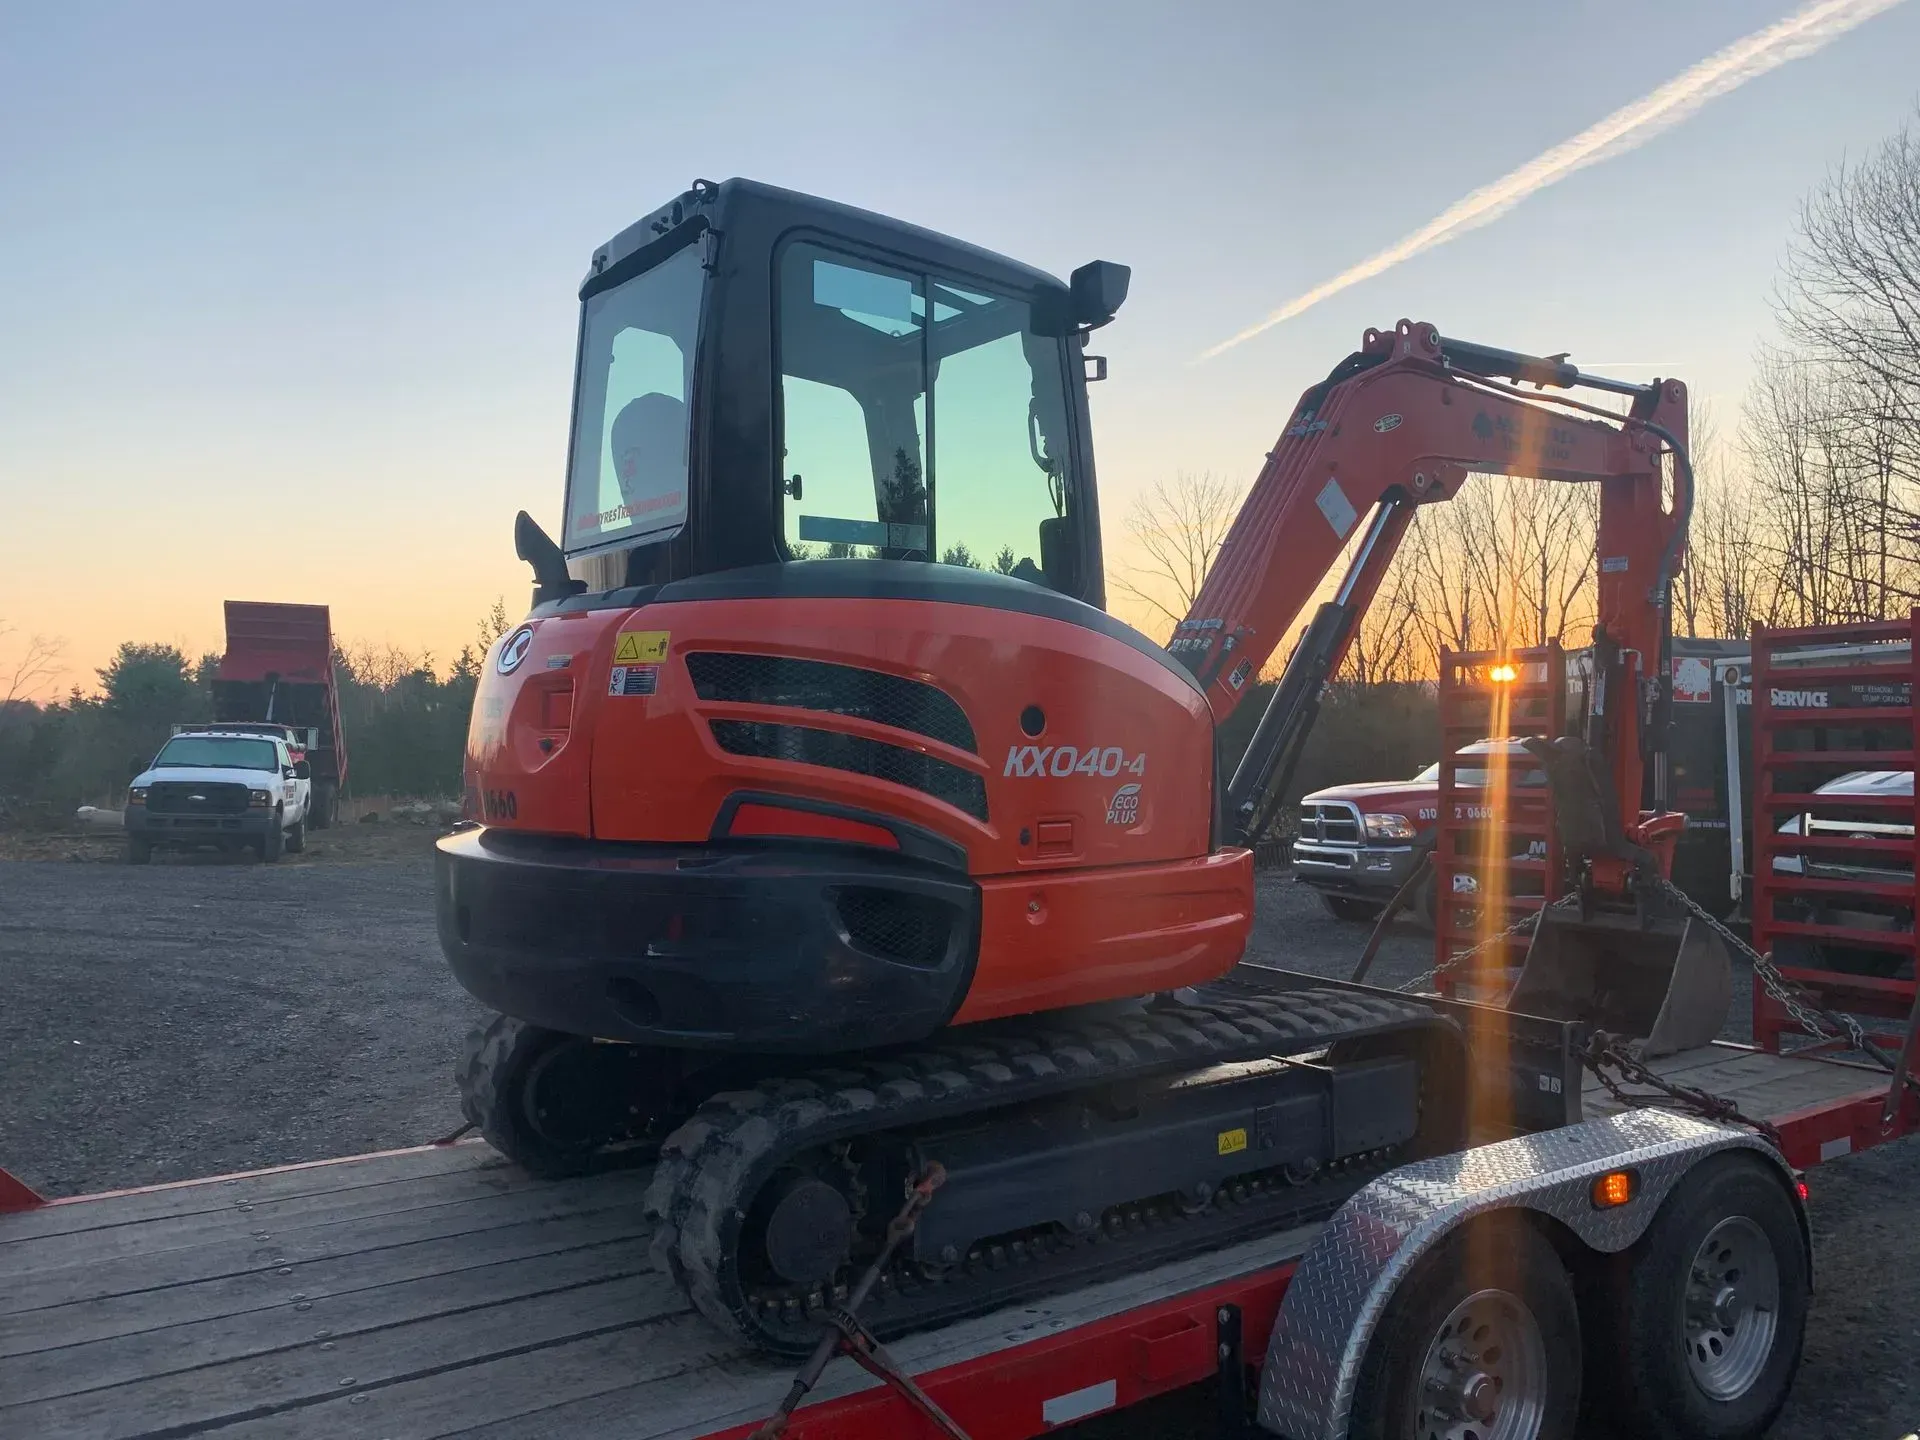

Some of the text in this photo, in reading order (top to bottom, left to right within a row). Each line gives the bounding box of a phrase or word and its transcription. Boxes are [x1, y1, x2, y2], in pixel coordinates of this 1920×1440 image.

[1771, 688, 1828, 707] SERVICE
[1003, 746, 1146, 777] KX040-4
[1115, 796, 1139, 809] eco
[1105, 810, 1137, 824] PLUS
[1419, 808, 1437, 819] 610
